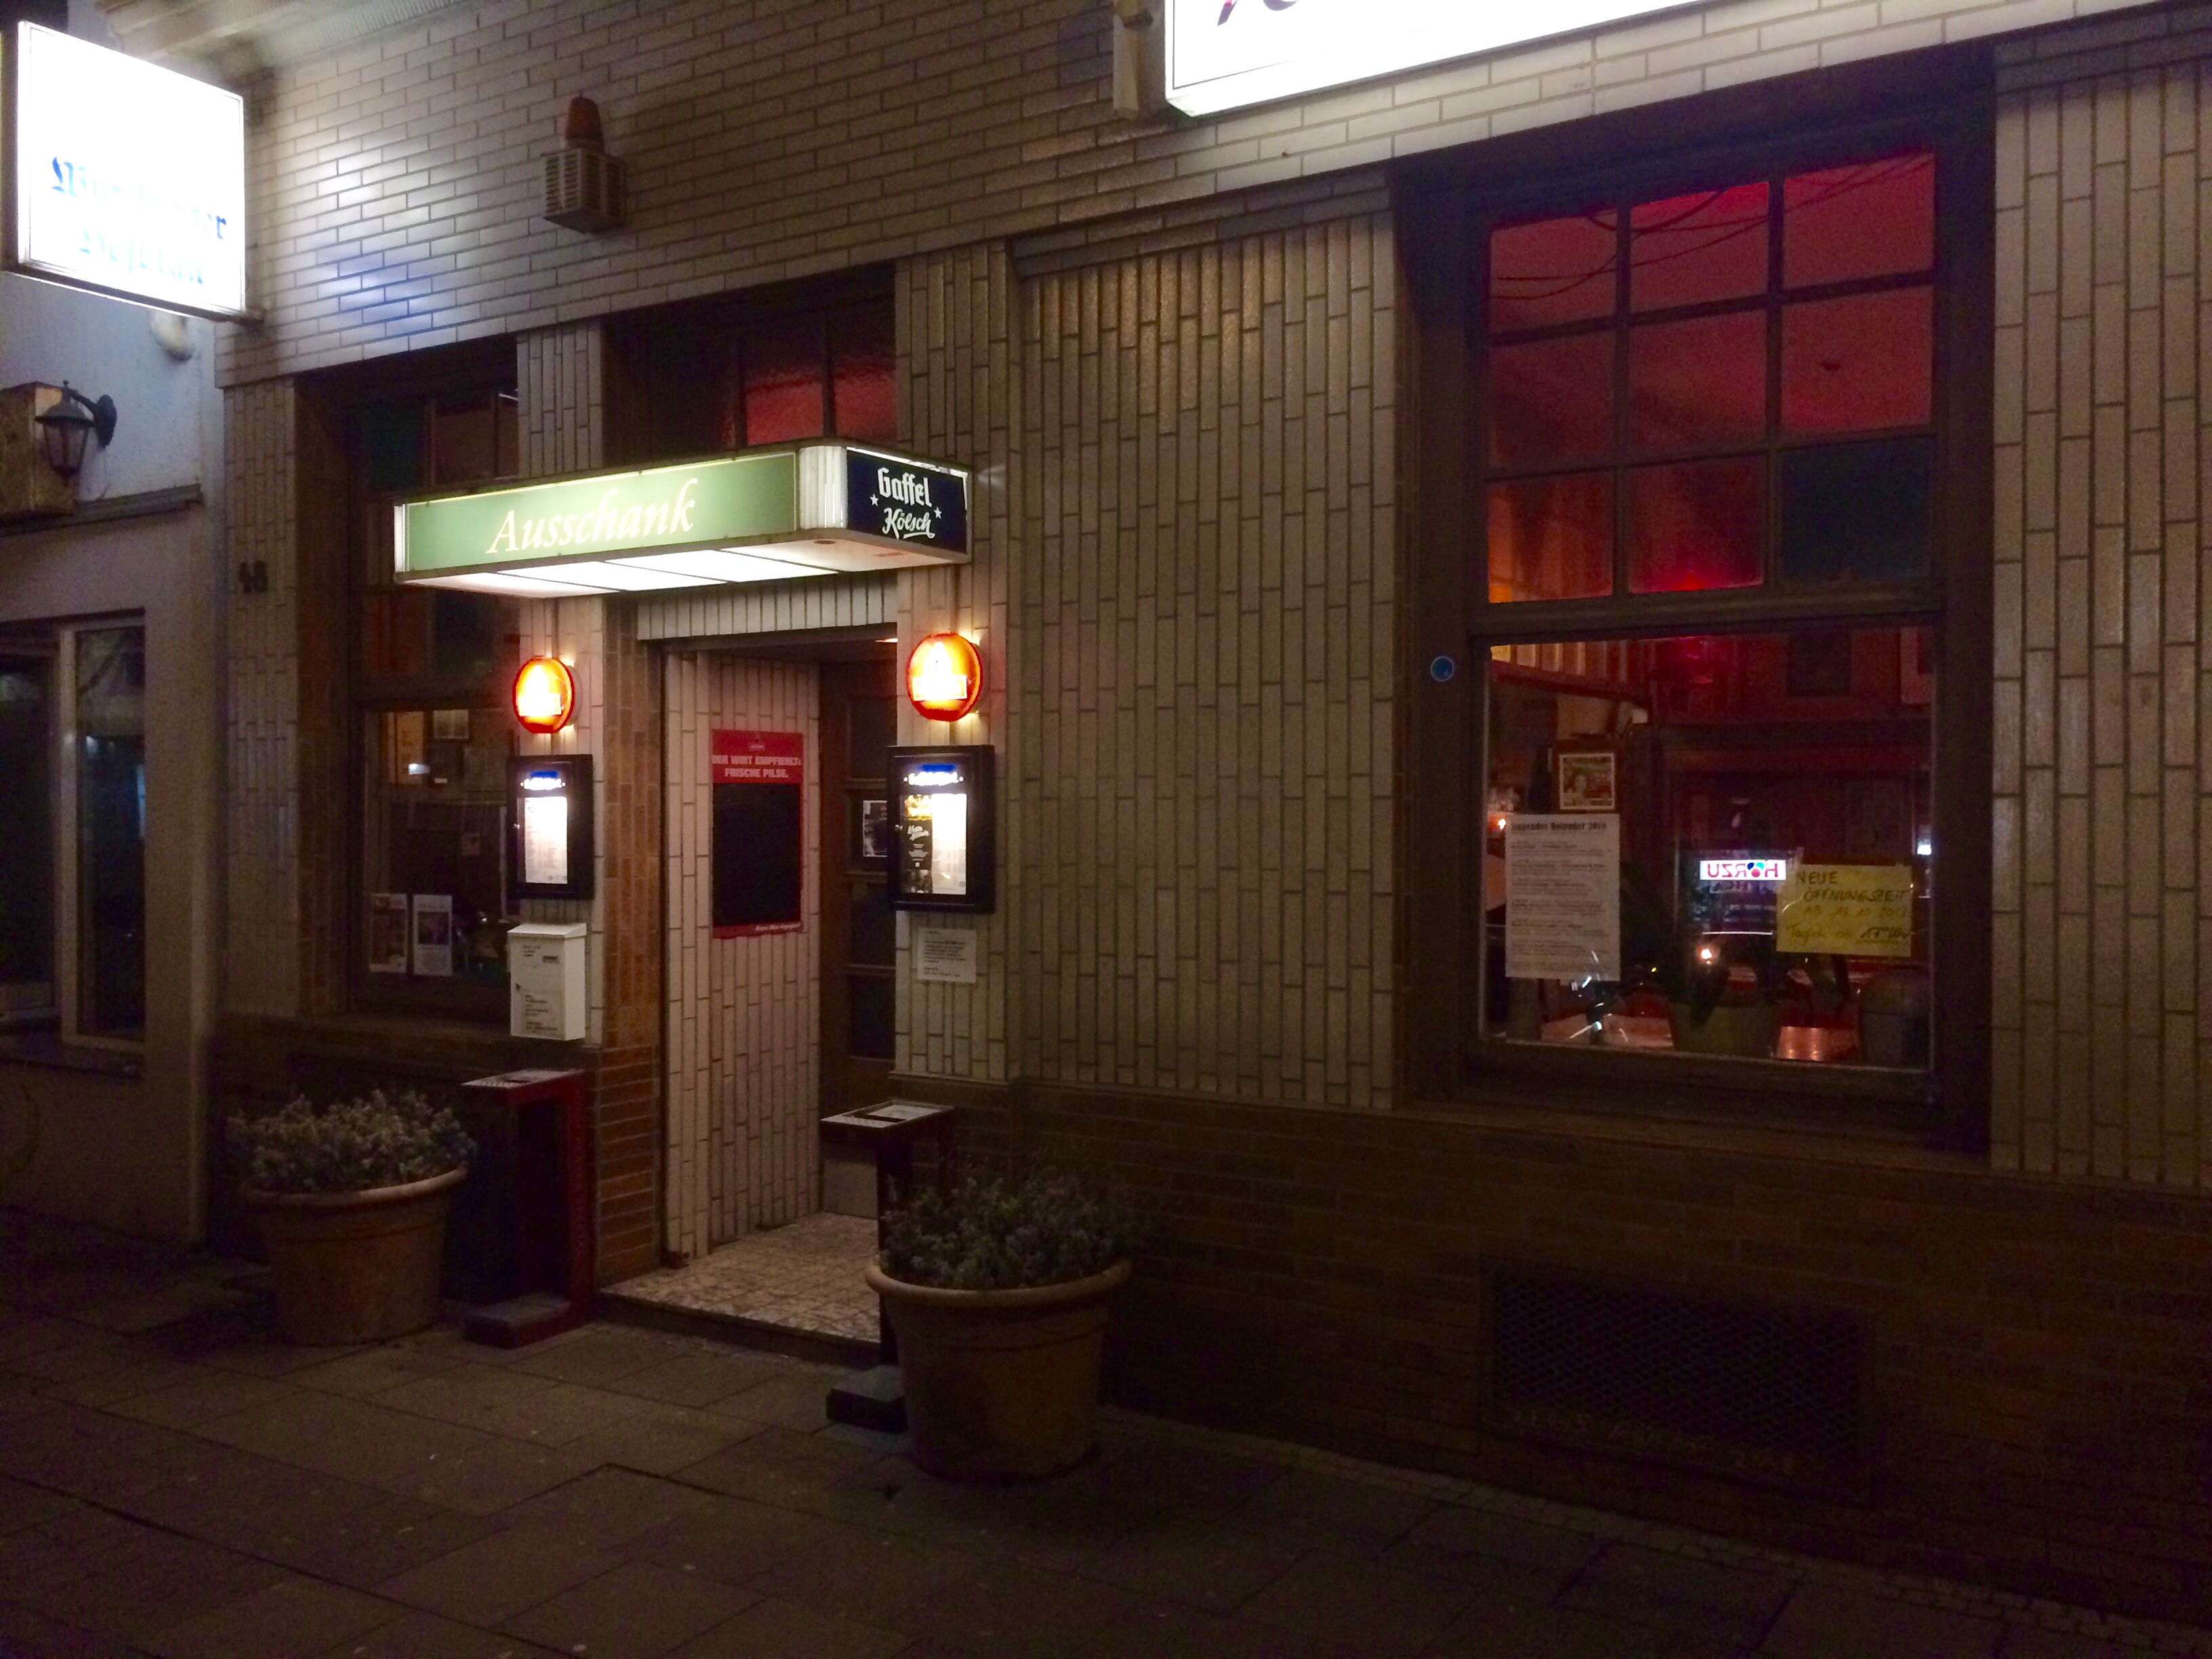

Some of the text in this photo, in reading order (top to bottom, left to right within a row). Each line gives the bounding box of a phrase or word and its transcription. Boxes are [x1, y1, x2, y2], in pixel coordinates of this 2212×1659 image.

[877, 467, 933, 507] Gaffel
[485, 478, 698, 553] Ausschank
[882, 508, 935, 539] Kölsch
[712, 755, 729, 764] DER
[731, 756, 753, 765] WIRT
[724, 768, 790, 778] FRISCHE PILSE.
[1796, 872, 1838, 885] NEUE
